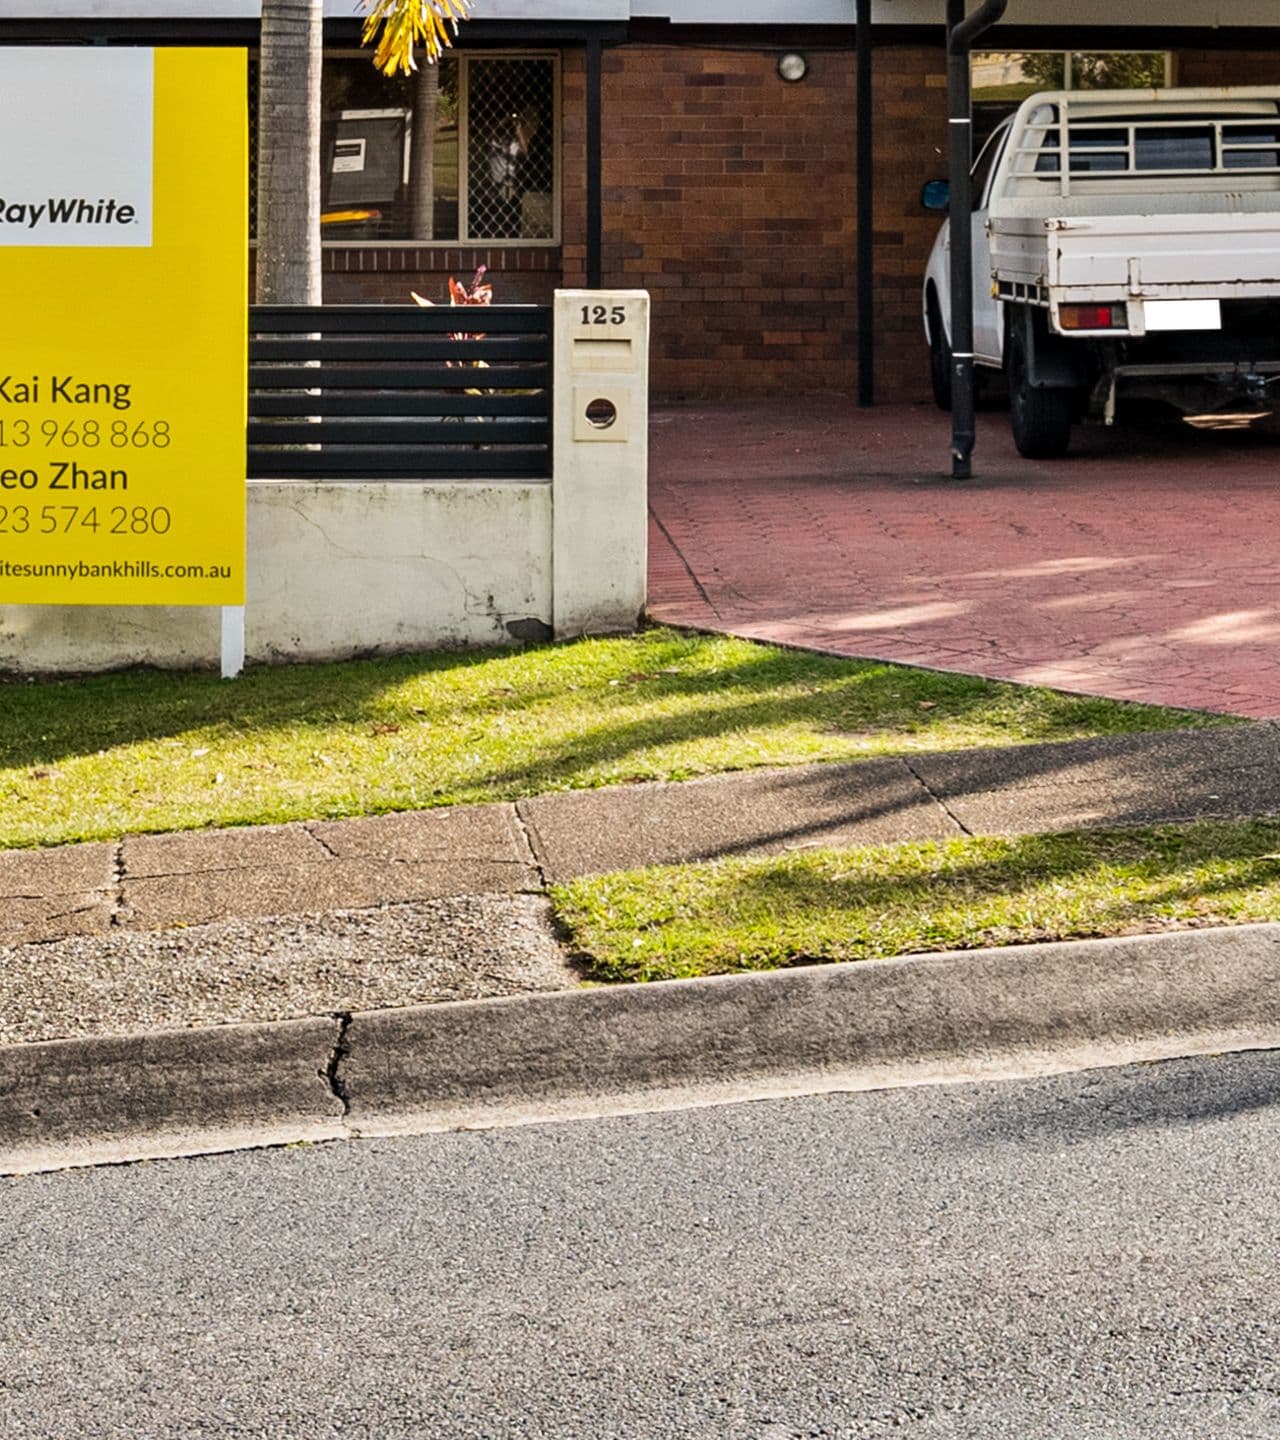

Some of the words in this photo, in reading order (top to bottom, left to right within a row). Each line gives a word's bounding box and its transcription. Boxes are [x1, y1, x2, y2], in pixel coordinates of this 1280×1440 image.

[580, 305, 626, 326] 125
[51, 375, 132, 411] Kang
[40, 419, 101, 448] 968
[109, 419, 171, 449] 868
[47, 461, 128, 491] Zhan
[40, 505, 101, 534] 574
[109, 505, 171, 535] 280
